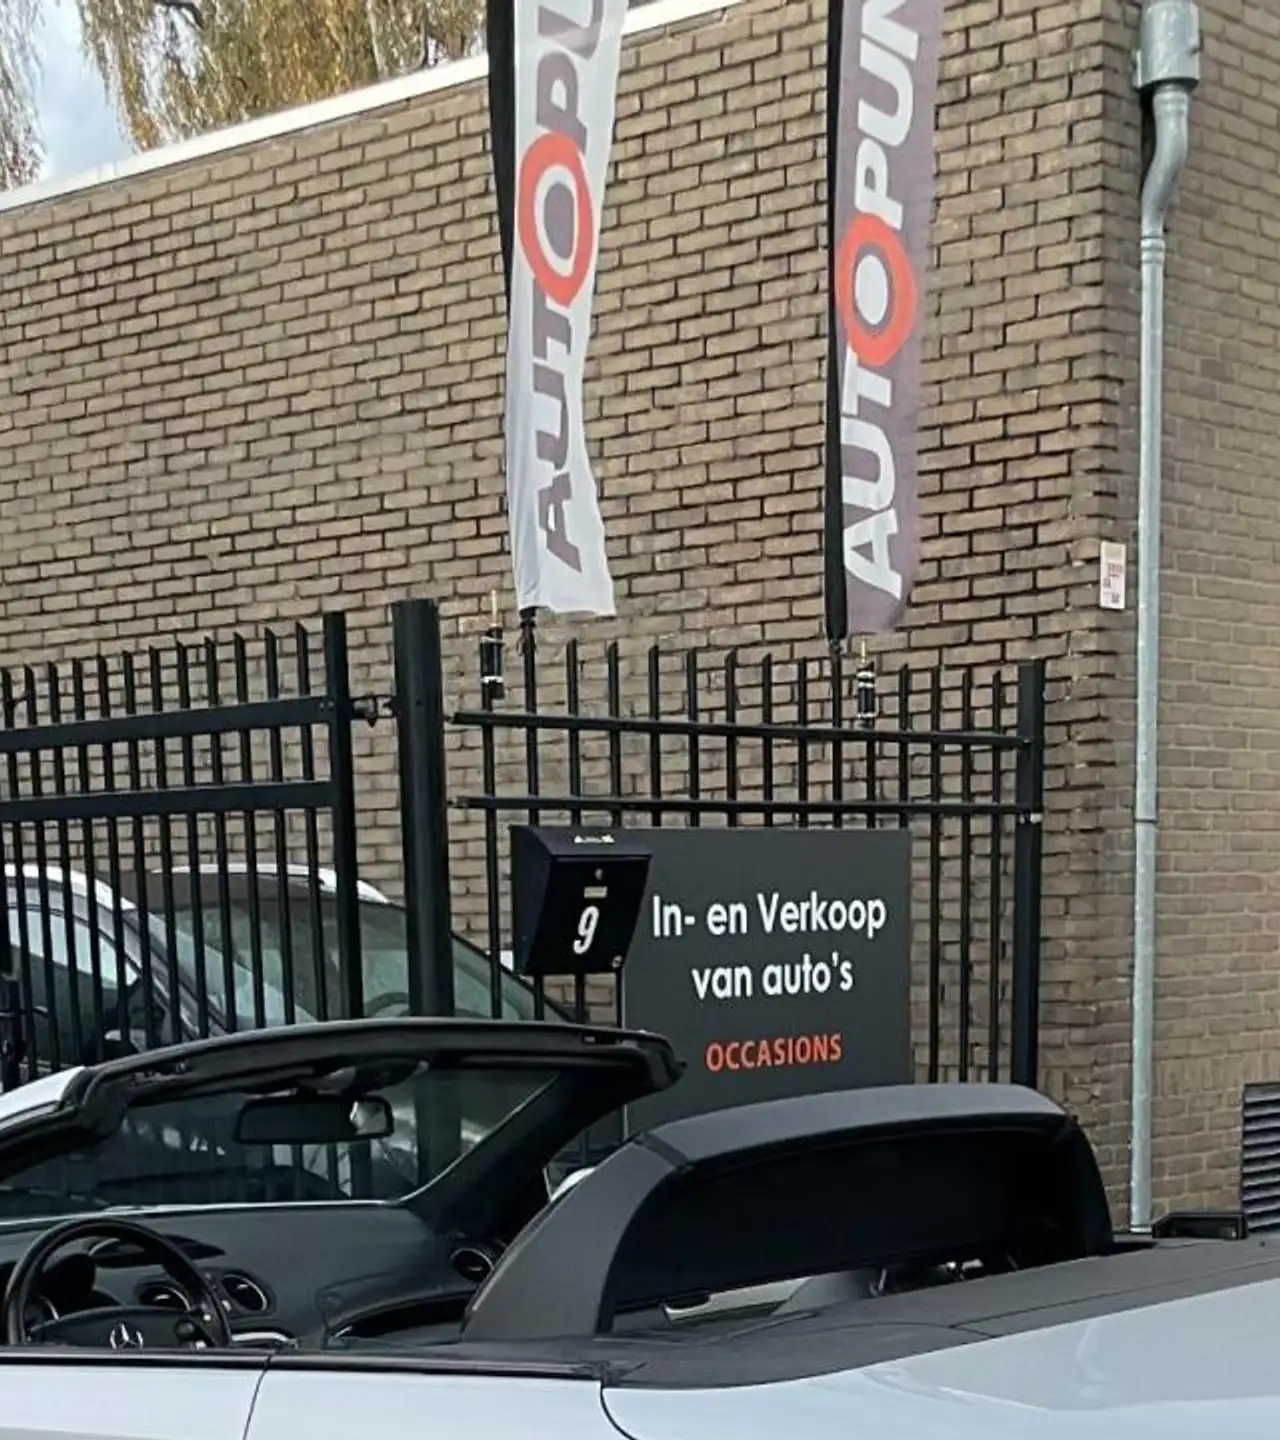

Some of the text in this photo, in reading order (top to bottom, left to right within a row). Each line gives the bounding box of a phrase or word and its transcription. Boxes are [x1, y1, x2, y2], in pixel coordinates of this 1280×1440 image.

[572, 905, 600, 955] 9
[652, 890, 887, 939] In- en Verkoop
[691, 951, 854, 1000] van auto's
[705, 1032, 843, 1072] OCCASIONS
